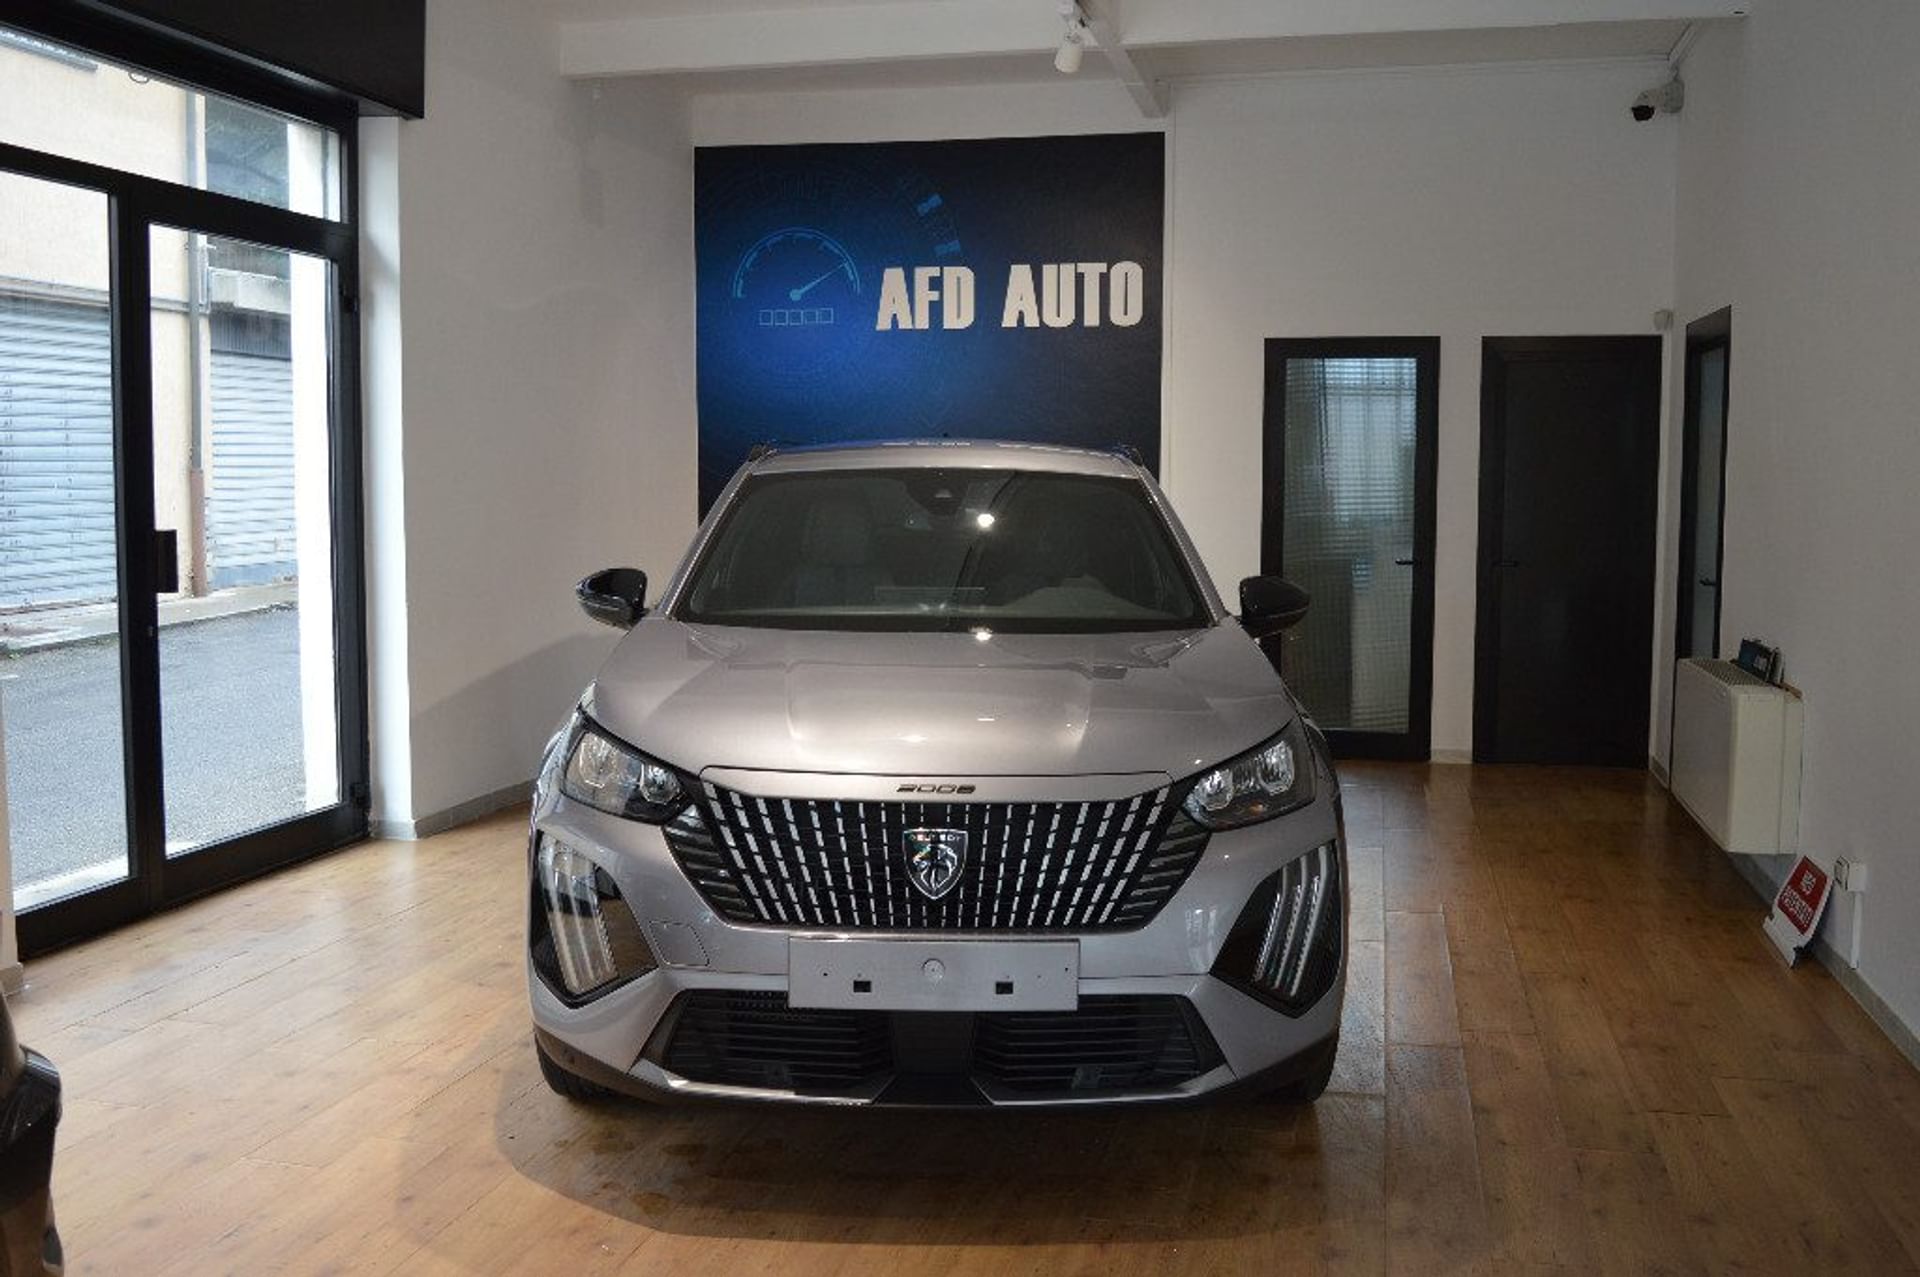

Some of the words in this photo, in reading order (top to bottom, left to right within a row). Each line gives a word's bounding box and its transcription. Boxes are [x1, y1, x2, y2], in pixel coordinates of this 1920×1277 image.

[875, 266, 975, 331] AFD
[1001, 260, 1144, 328] AUTO
[896, 785, 976, 794] 2008
